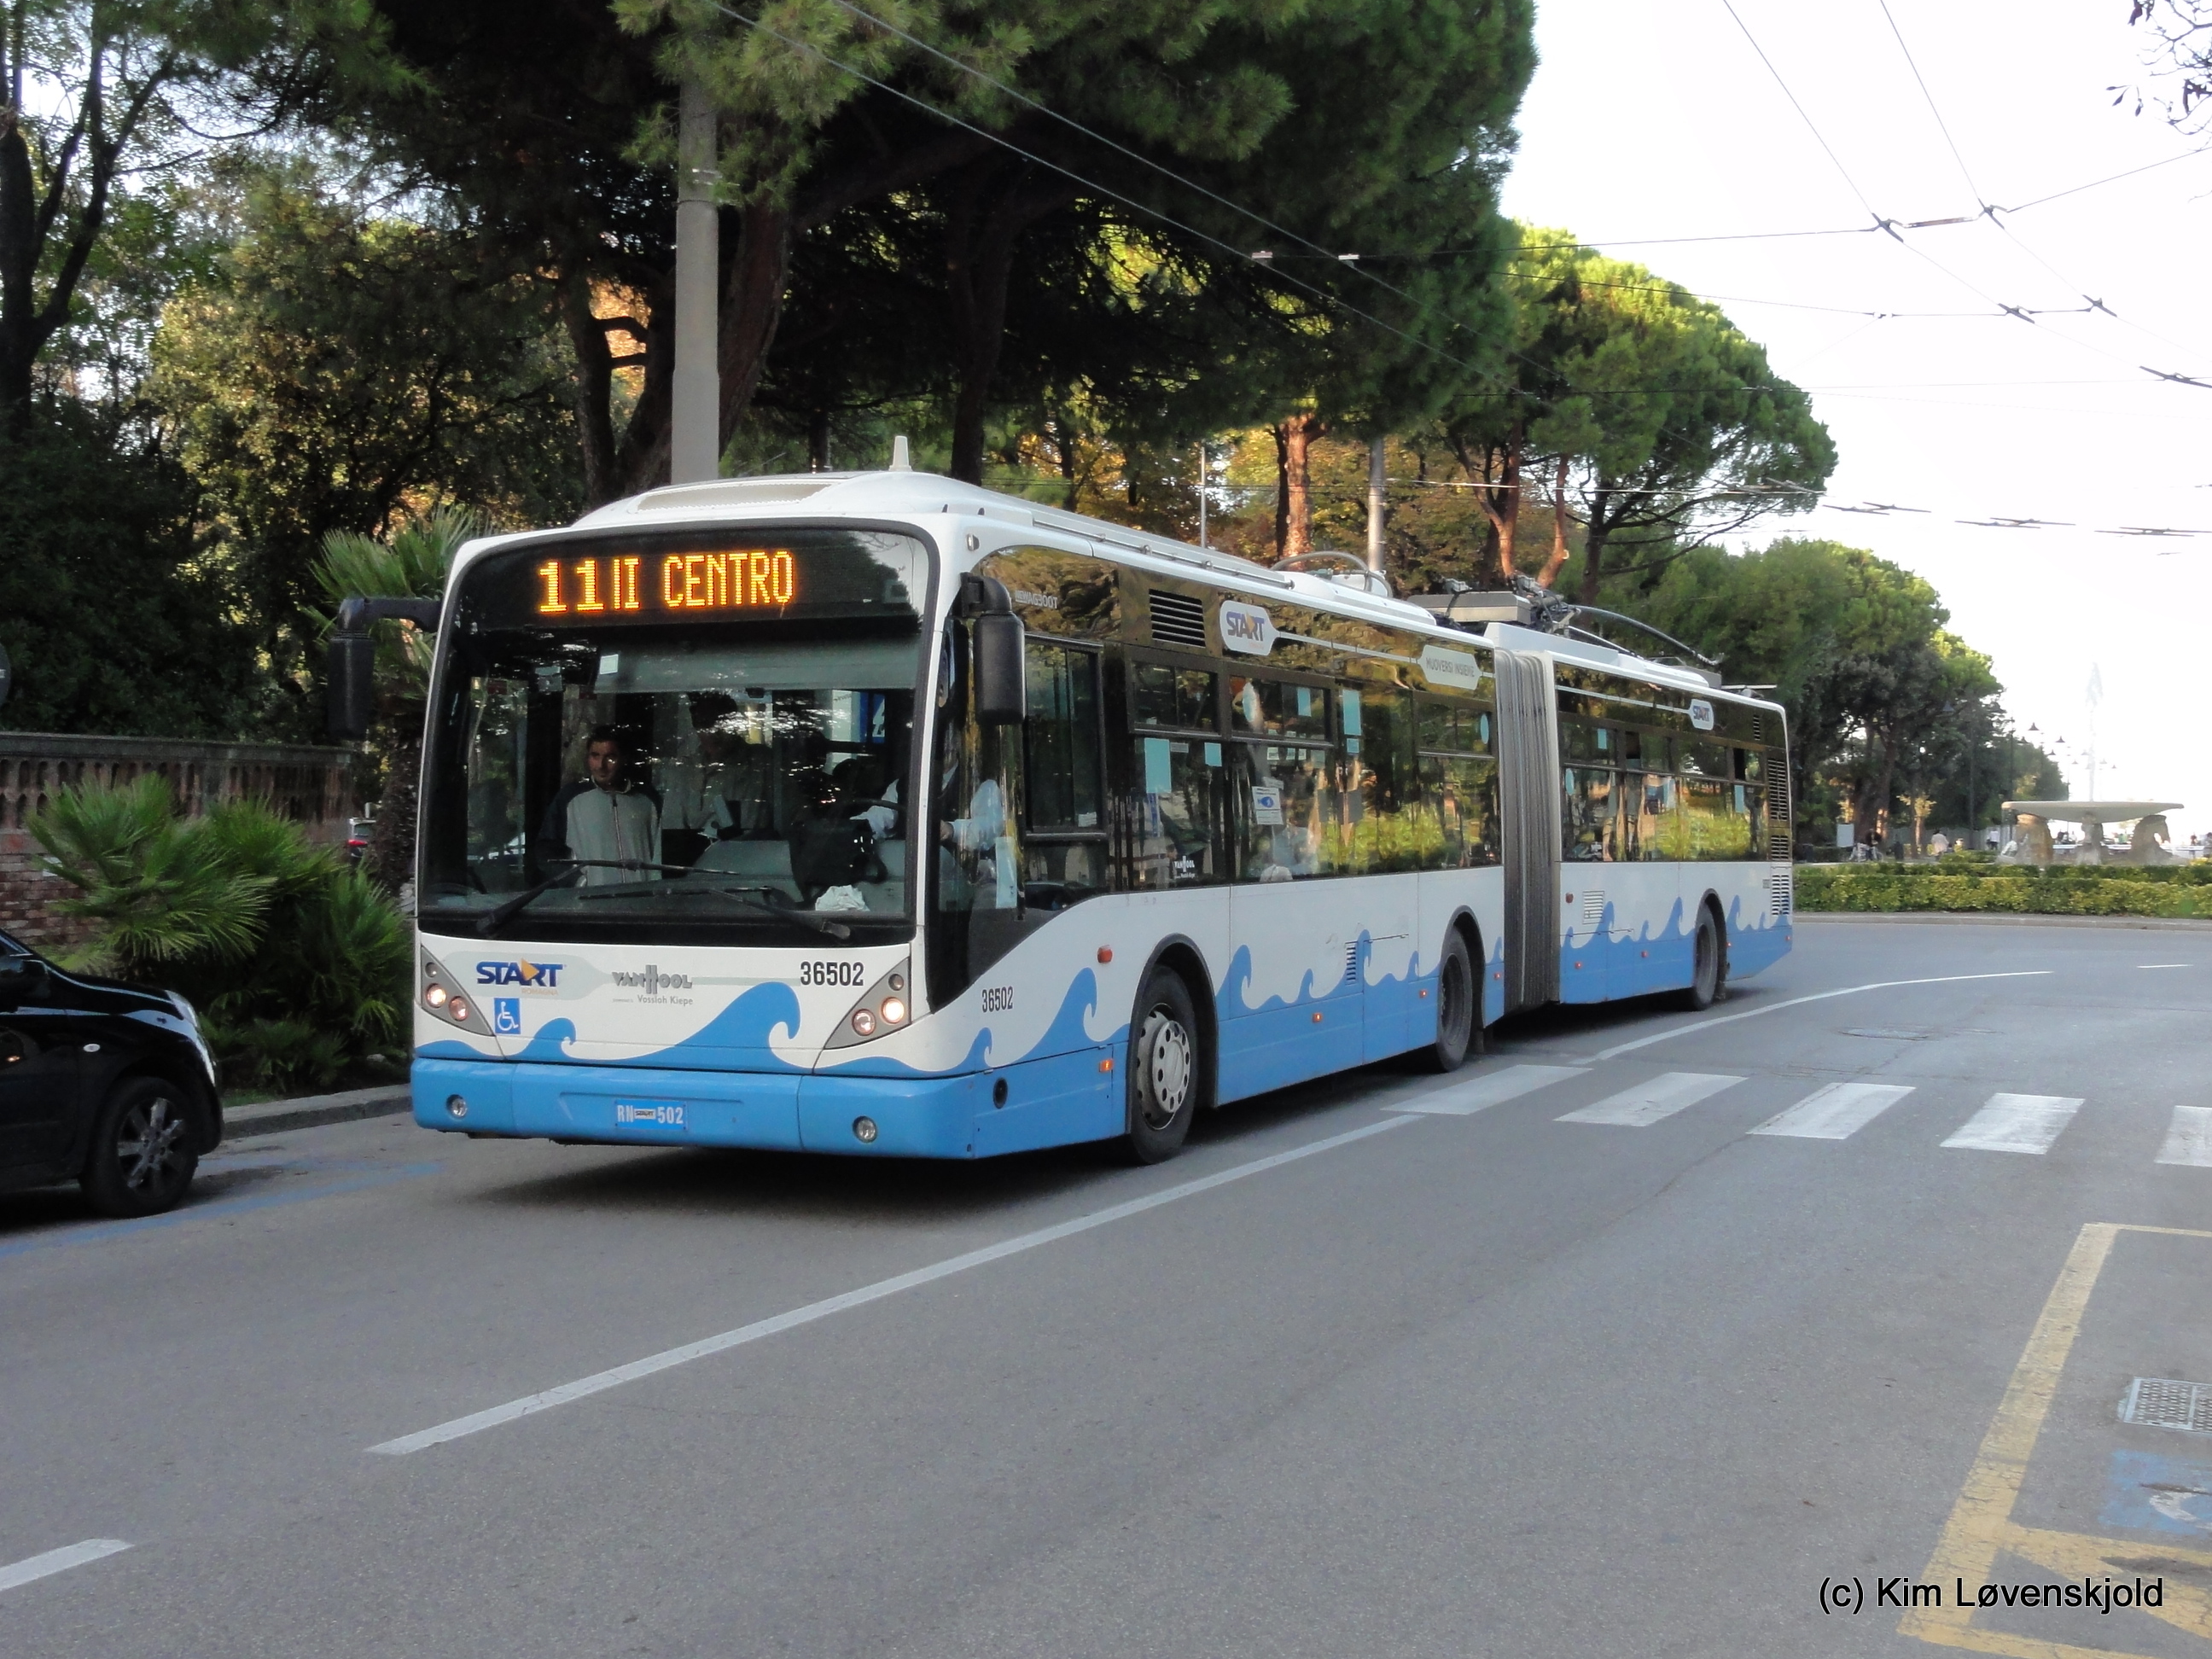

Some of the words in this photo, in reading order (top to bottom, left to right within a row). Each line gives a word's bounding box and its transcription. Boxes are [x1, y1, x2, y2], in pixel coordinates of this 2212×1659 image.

[664, 551, 793, 607] CENTRO
[1226, 611, 1265, 642] START
[475, 958, 564, 988] START
[800, 961, 864, 987] 36502
[637, 994, 667, 1004] Vossloh
[670, 996, 694, 1007] Kiepe
[981, 987, 1014, 1014] 36502
[617, 1104, 634, 1122] RN
[657, 1106, 684, 1124] 502
